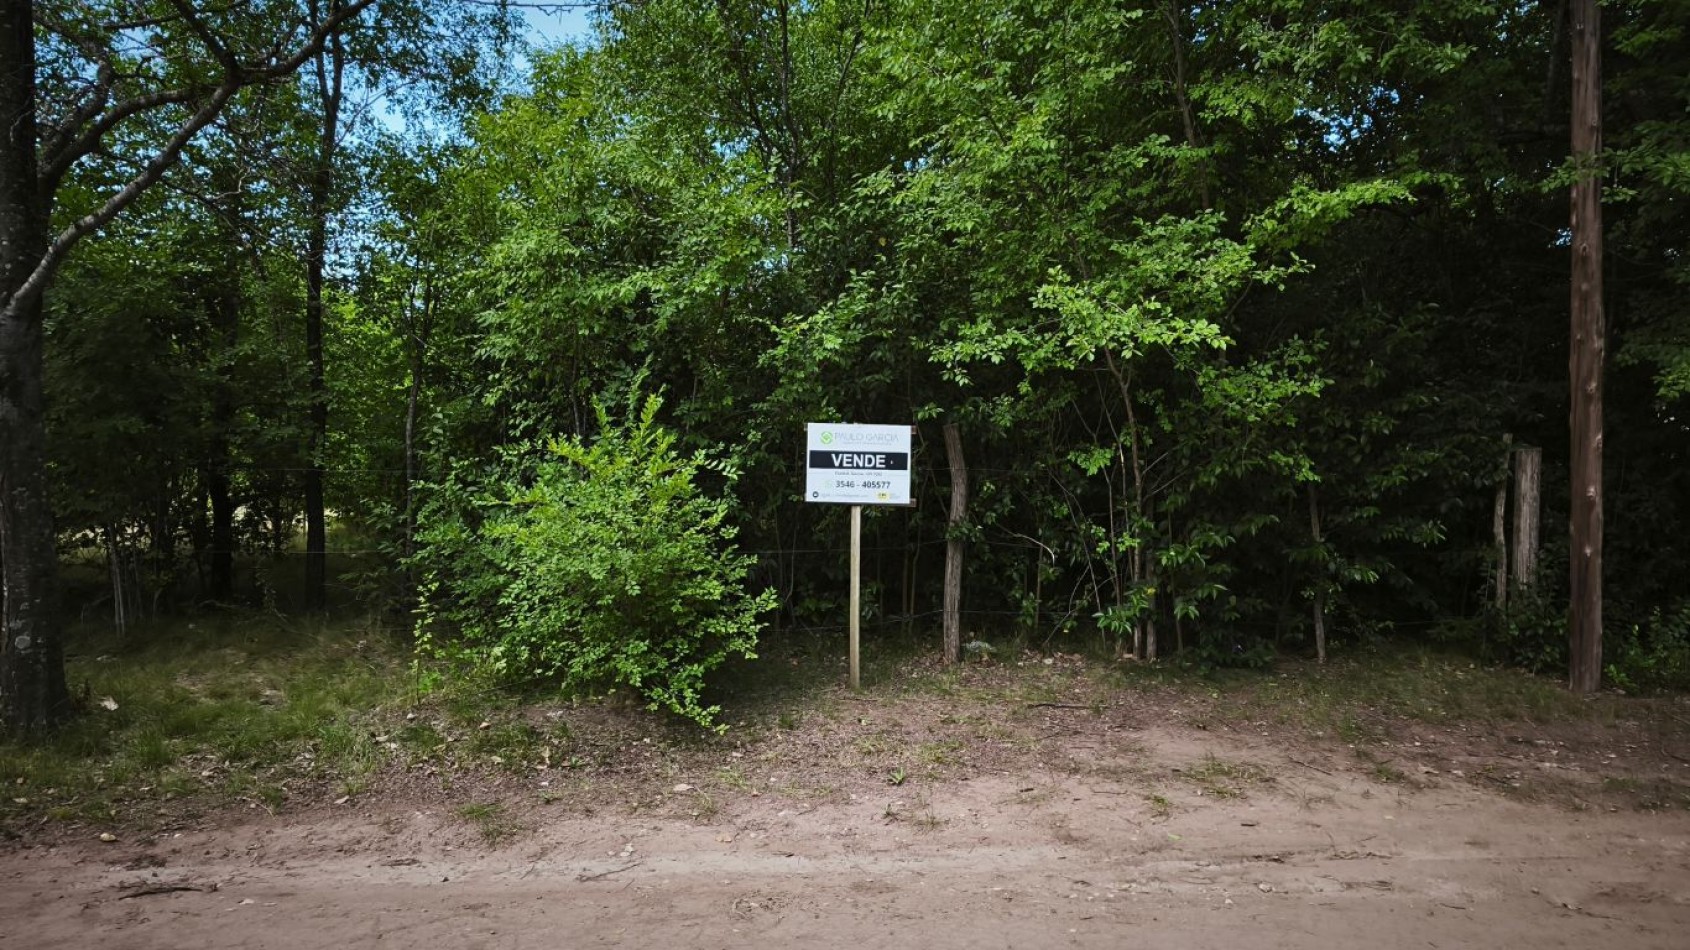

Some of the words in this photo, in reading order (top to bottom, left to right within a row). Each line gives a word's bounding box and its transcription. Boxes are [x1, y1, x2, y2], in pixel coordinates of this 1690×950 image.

[834, 432, 864, 441] PAULO
[831, 453, 886, 468] VENDE
[835, 480, 855, 488] 3546
[862, 480, 891, 489] 405577
